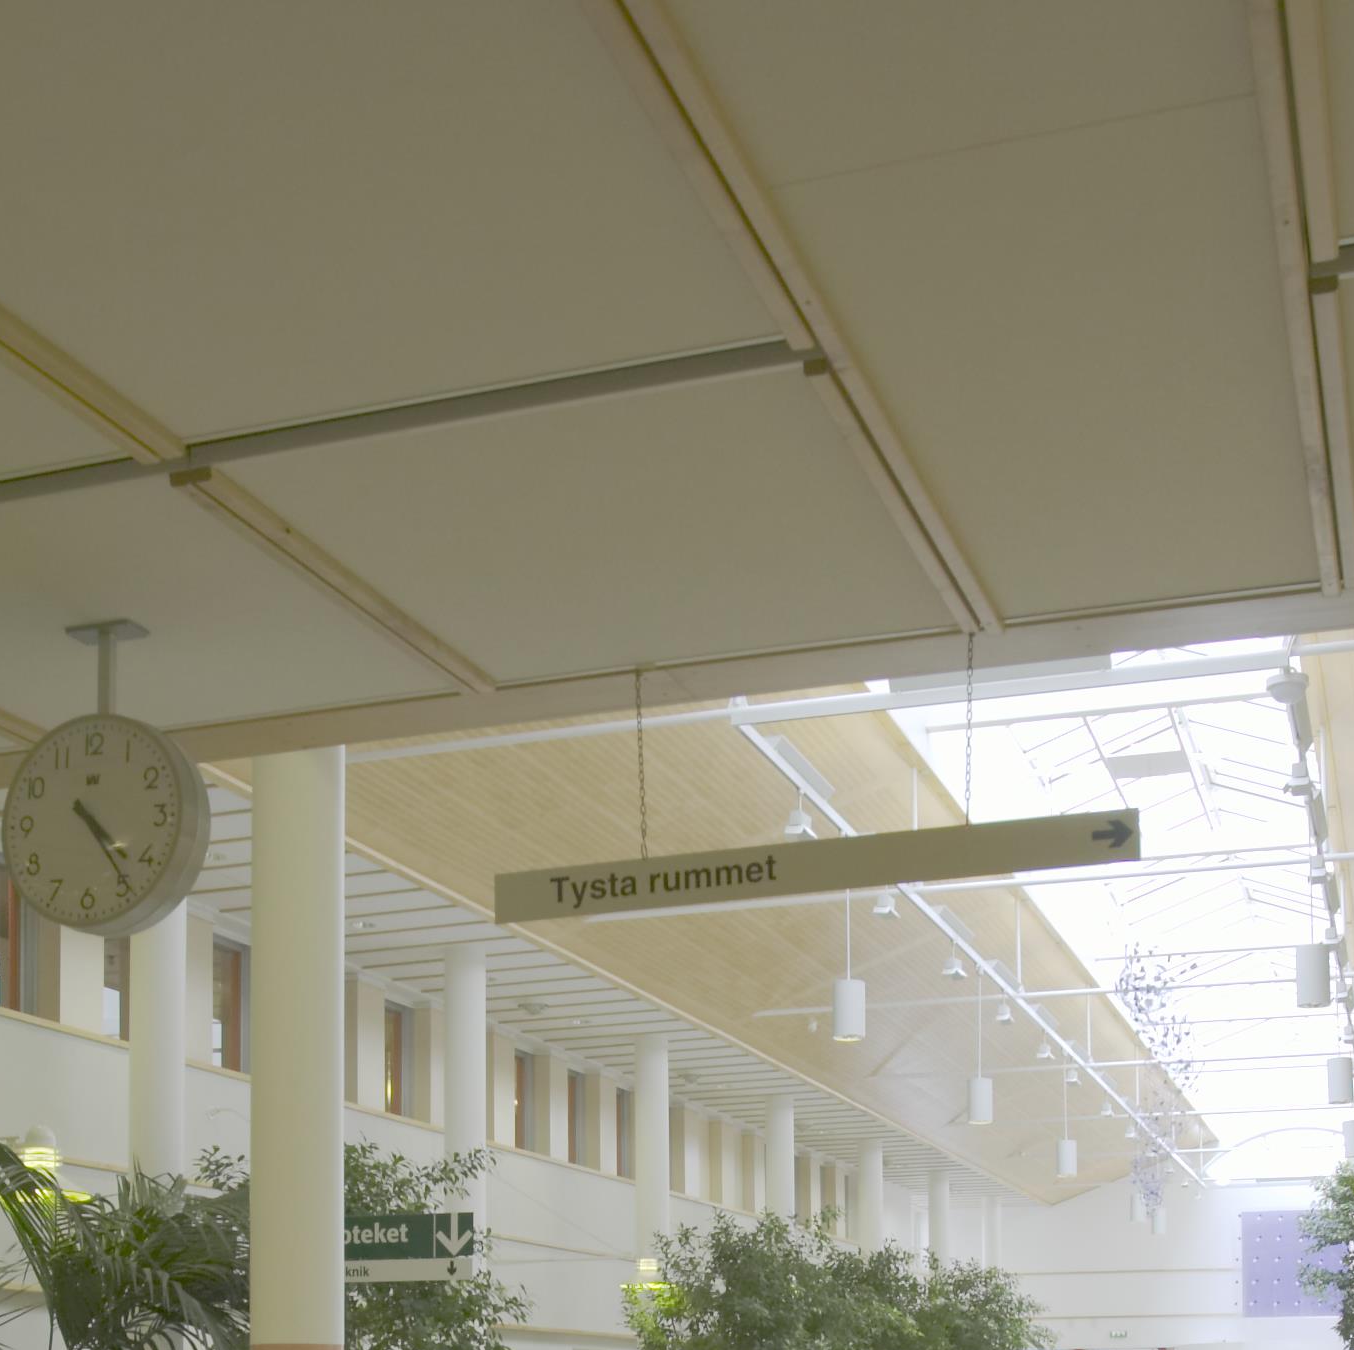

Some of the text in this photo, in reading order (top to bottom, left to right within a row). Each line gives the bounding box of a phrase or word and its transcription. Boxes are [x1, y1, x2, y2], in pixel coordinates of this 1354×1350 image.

[85, 731, 105, 757] 12
[125, 740, 131, 763] 1
[55, 746, 70, 770] 11
[28, 776, 45, 799] 10
[144, 766, 159, 790] 2
[20, 815, 34, 839] 9
[153, 804, 167, 827] 3
[26, 852, 41, 876] 8
[138, 843, 154, 867] 4
[49, 879, 64, 901] 7
[115, 873, 130, 898] 5
[549, 854, 778, 909] Tysta rummet
[80, 887, 95, 910] 6
[344, 1222, 409, 1246] oteket
[345, 1265, 371, 1278] knik
